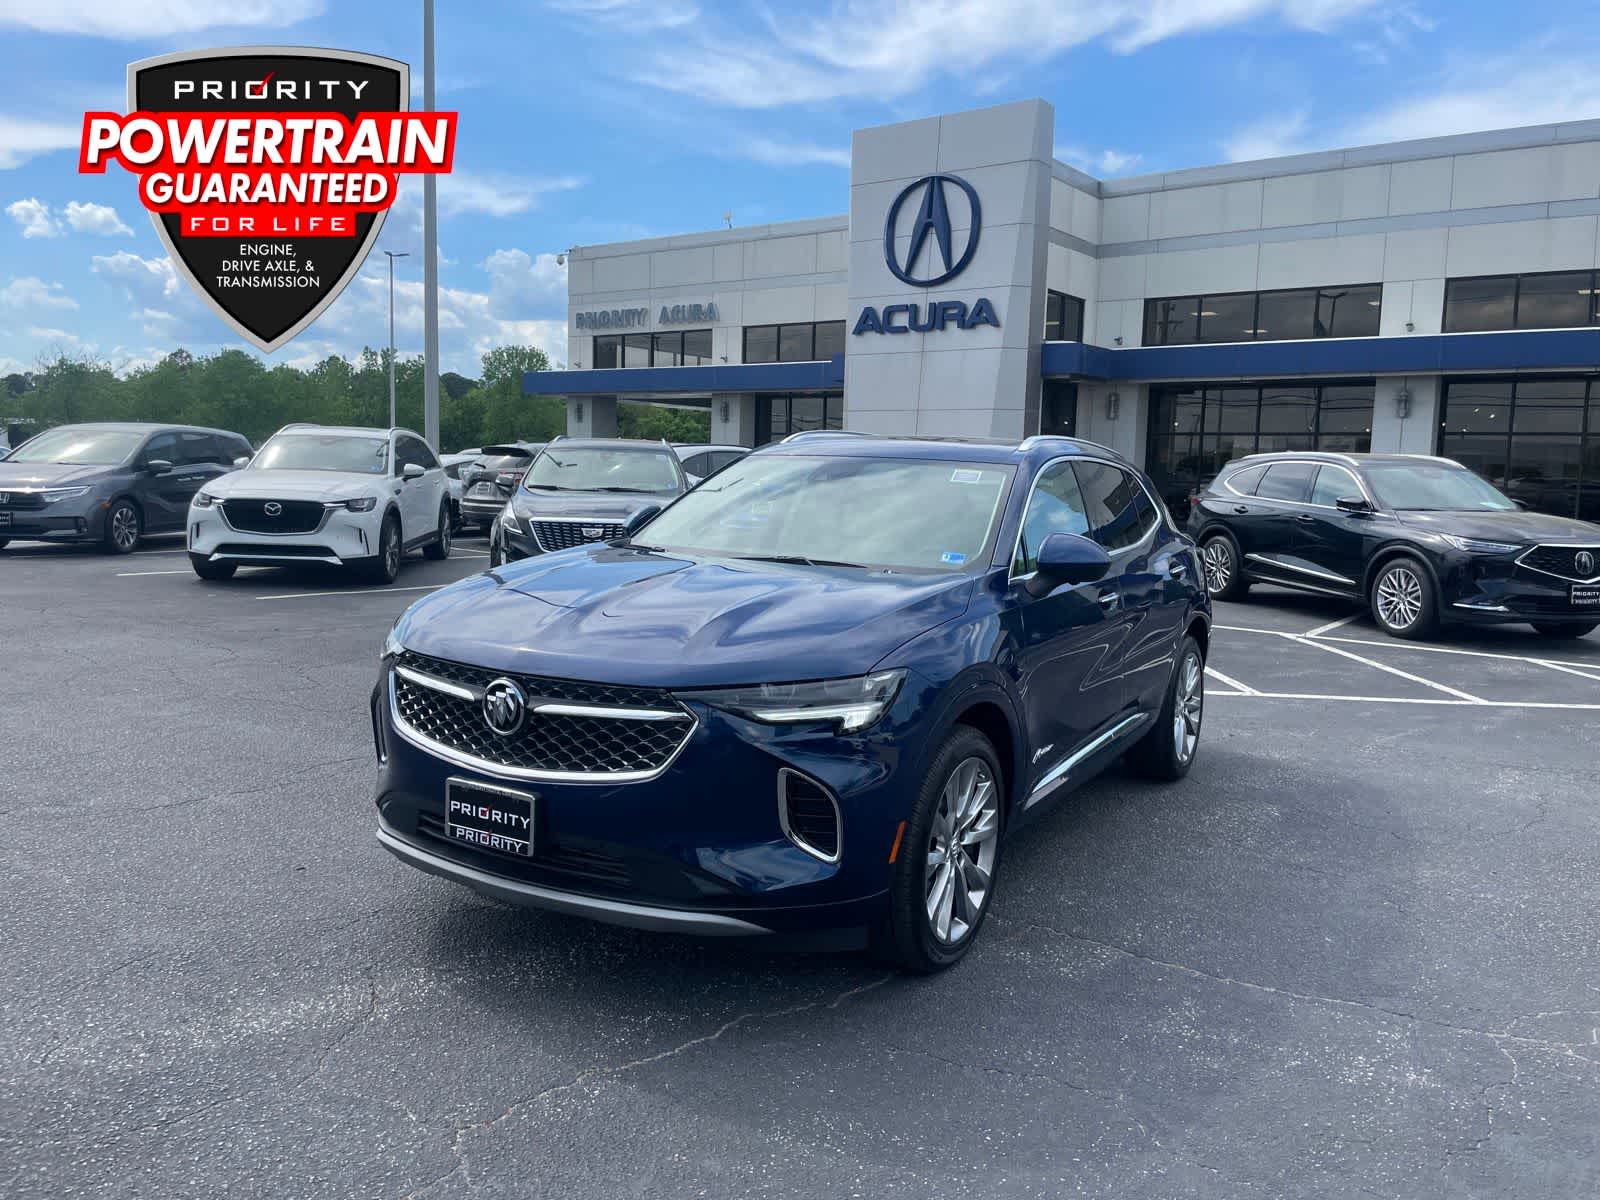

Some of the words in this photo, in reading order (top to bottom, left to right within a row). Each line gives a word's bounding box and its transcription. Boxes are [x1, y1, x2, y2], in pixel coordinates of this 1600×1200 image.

[575, 308, 648, 330] PRIORITY
[658, 302, 720, 323] ACURA
[852, 298, 1001, 335] ACURA
[450, 800, 530, 829] PRIORITY
[456, 828, 522, 852] PRIORITY
